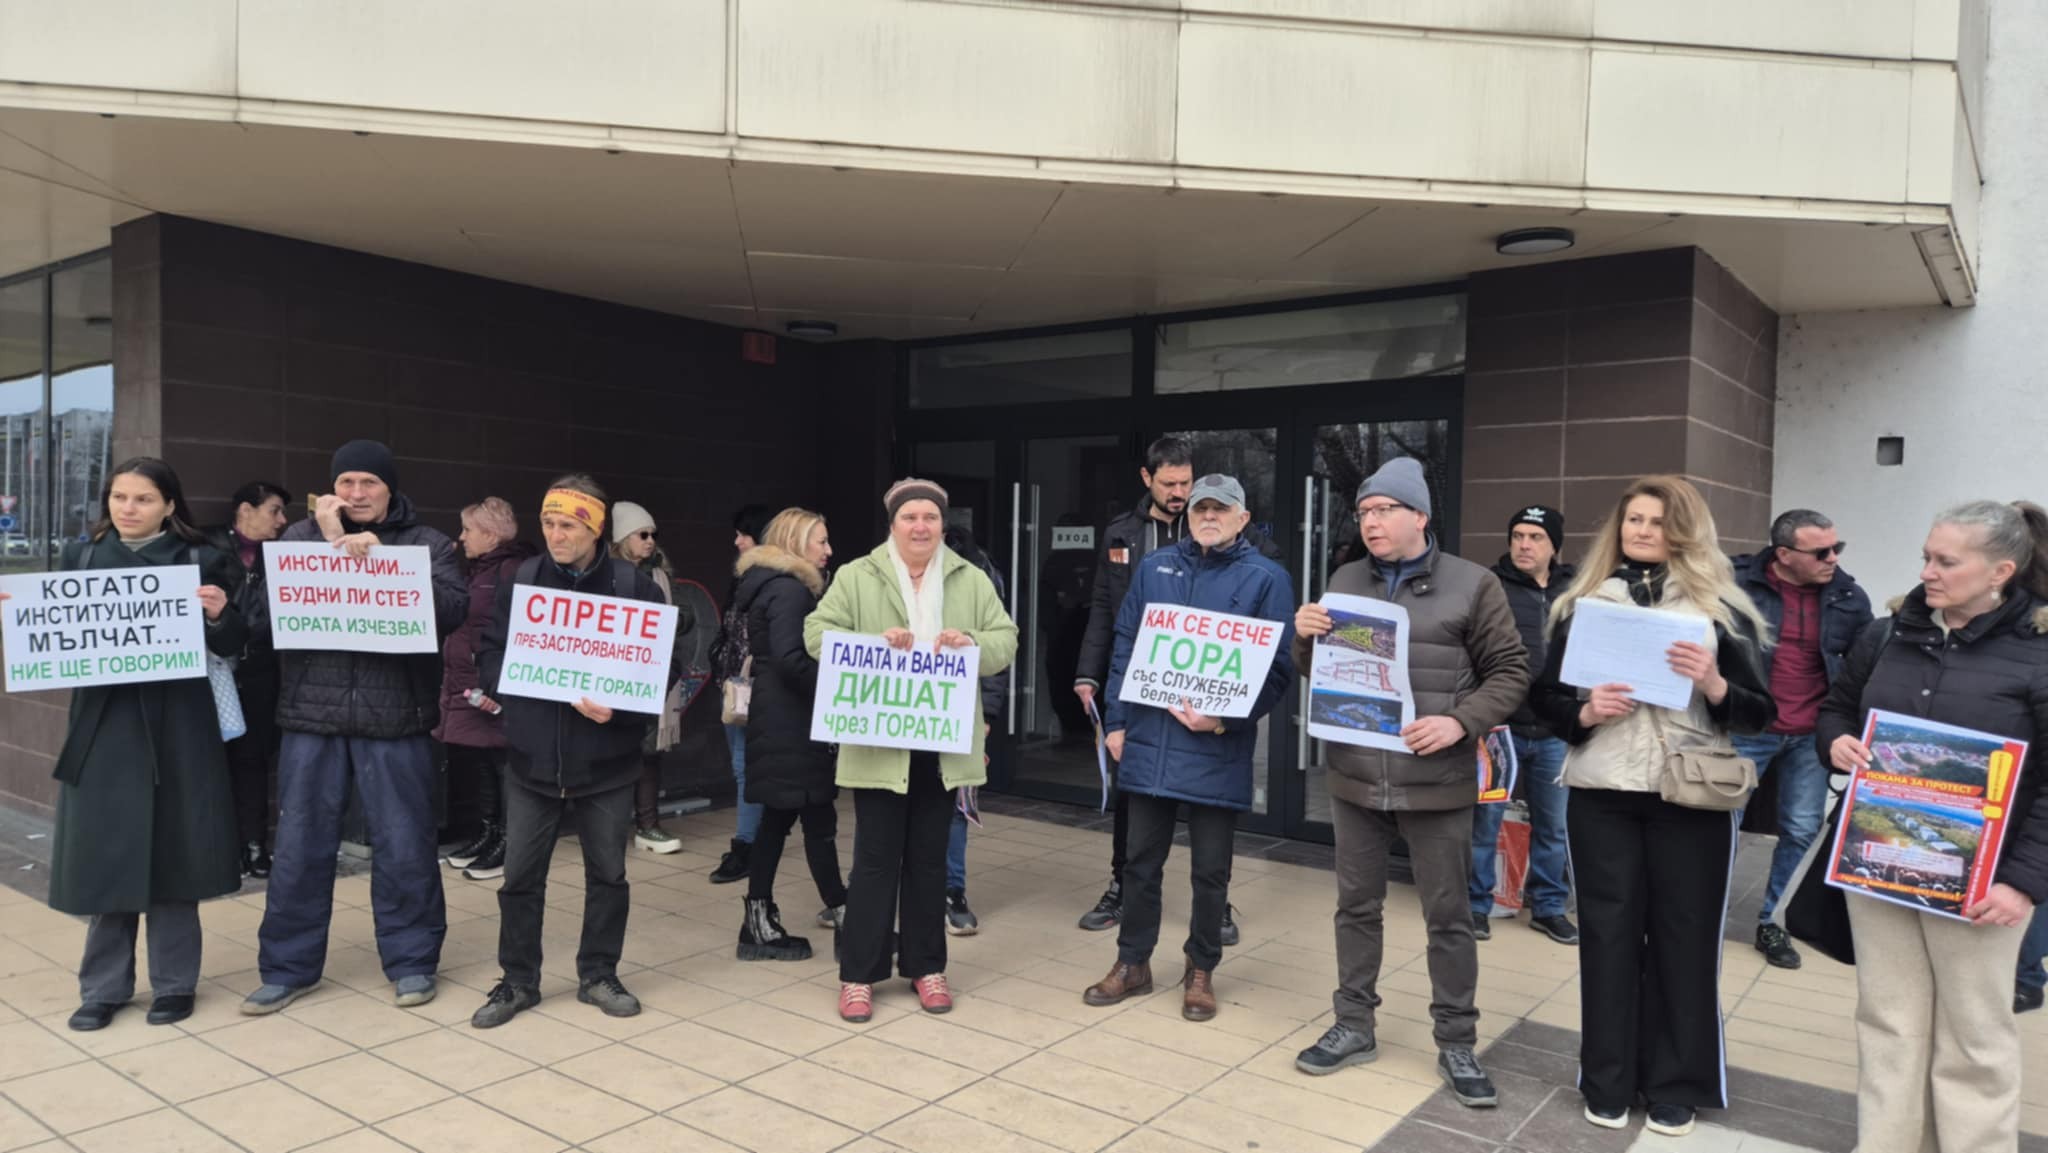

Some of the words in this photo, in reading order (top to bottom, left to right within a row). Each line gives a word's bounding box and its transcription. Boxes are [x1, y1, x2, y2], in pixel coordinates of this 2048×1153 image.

[1057, 533, 1089, 544] ВХОД
[278, 555, 416, 577] ИНСТИТУЦИИ...
[42, 574, 159, 599] КОГАТО
[279, 587, 341, 605] БУДНИ
[347, 588, 370, 604] ЛИ
[376, 590, 420, 606] СТЕ?
[16, 599, 188, 626] ИНСТИТУЦИИТЕ
[278, 616, 342, 632] ГОРАТА
[347, 618, 426, 636] ИЗЧЕЗВА!
[526, 594, 661, 640] СПРЕТЕ
[29, 625, 179, 652] МЪЛЧАТ...
[1145, 609, 1179, 630] КАК
[1184, 614, 1211, 636] СЕ
[1217, 620, 1273, 646] СЕЧЕ
[514, 633, 661, 665] ПРЕ-ЗАСТРОЯВАНЕТО...
[831, 643, 892, 670] ГАЛАТА
[897, 656, 906, 671] и
[911, 651, 966, 677] ВАРНА
[1149, 634, 1241, 679] ГОРА
[11, 661, 52, 680] НИЕ
[60, 659, 92, 679] ЩЕ
[99, 651, 198, 674] ГОВОРИМ!
[508, 663, 592, 690] СПАСЕТЕ
[595, 676, 658, 700] ГОРАТА!
[833, 672, 957, 711] ДИШАТ
[1133, 669, 1157, 683] със
[1162, 671, 1248, 697] СЛУЖЕБНА
[824, 714, 868, 737] чрез
[874, 712, 960, 742] ГОРАТА!
[1867, 770, 1907, 785] ПОКАНА
[1910, 777, 1923, 787] ЗА
[1927, 779, 1971, 794] ПРОТЕСТ
